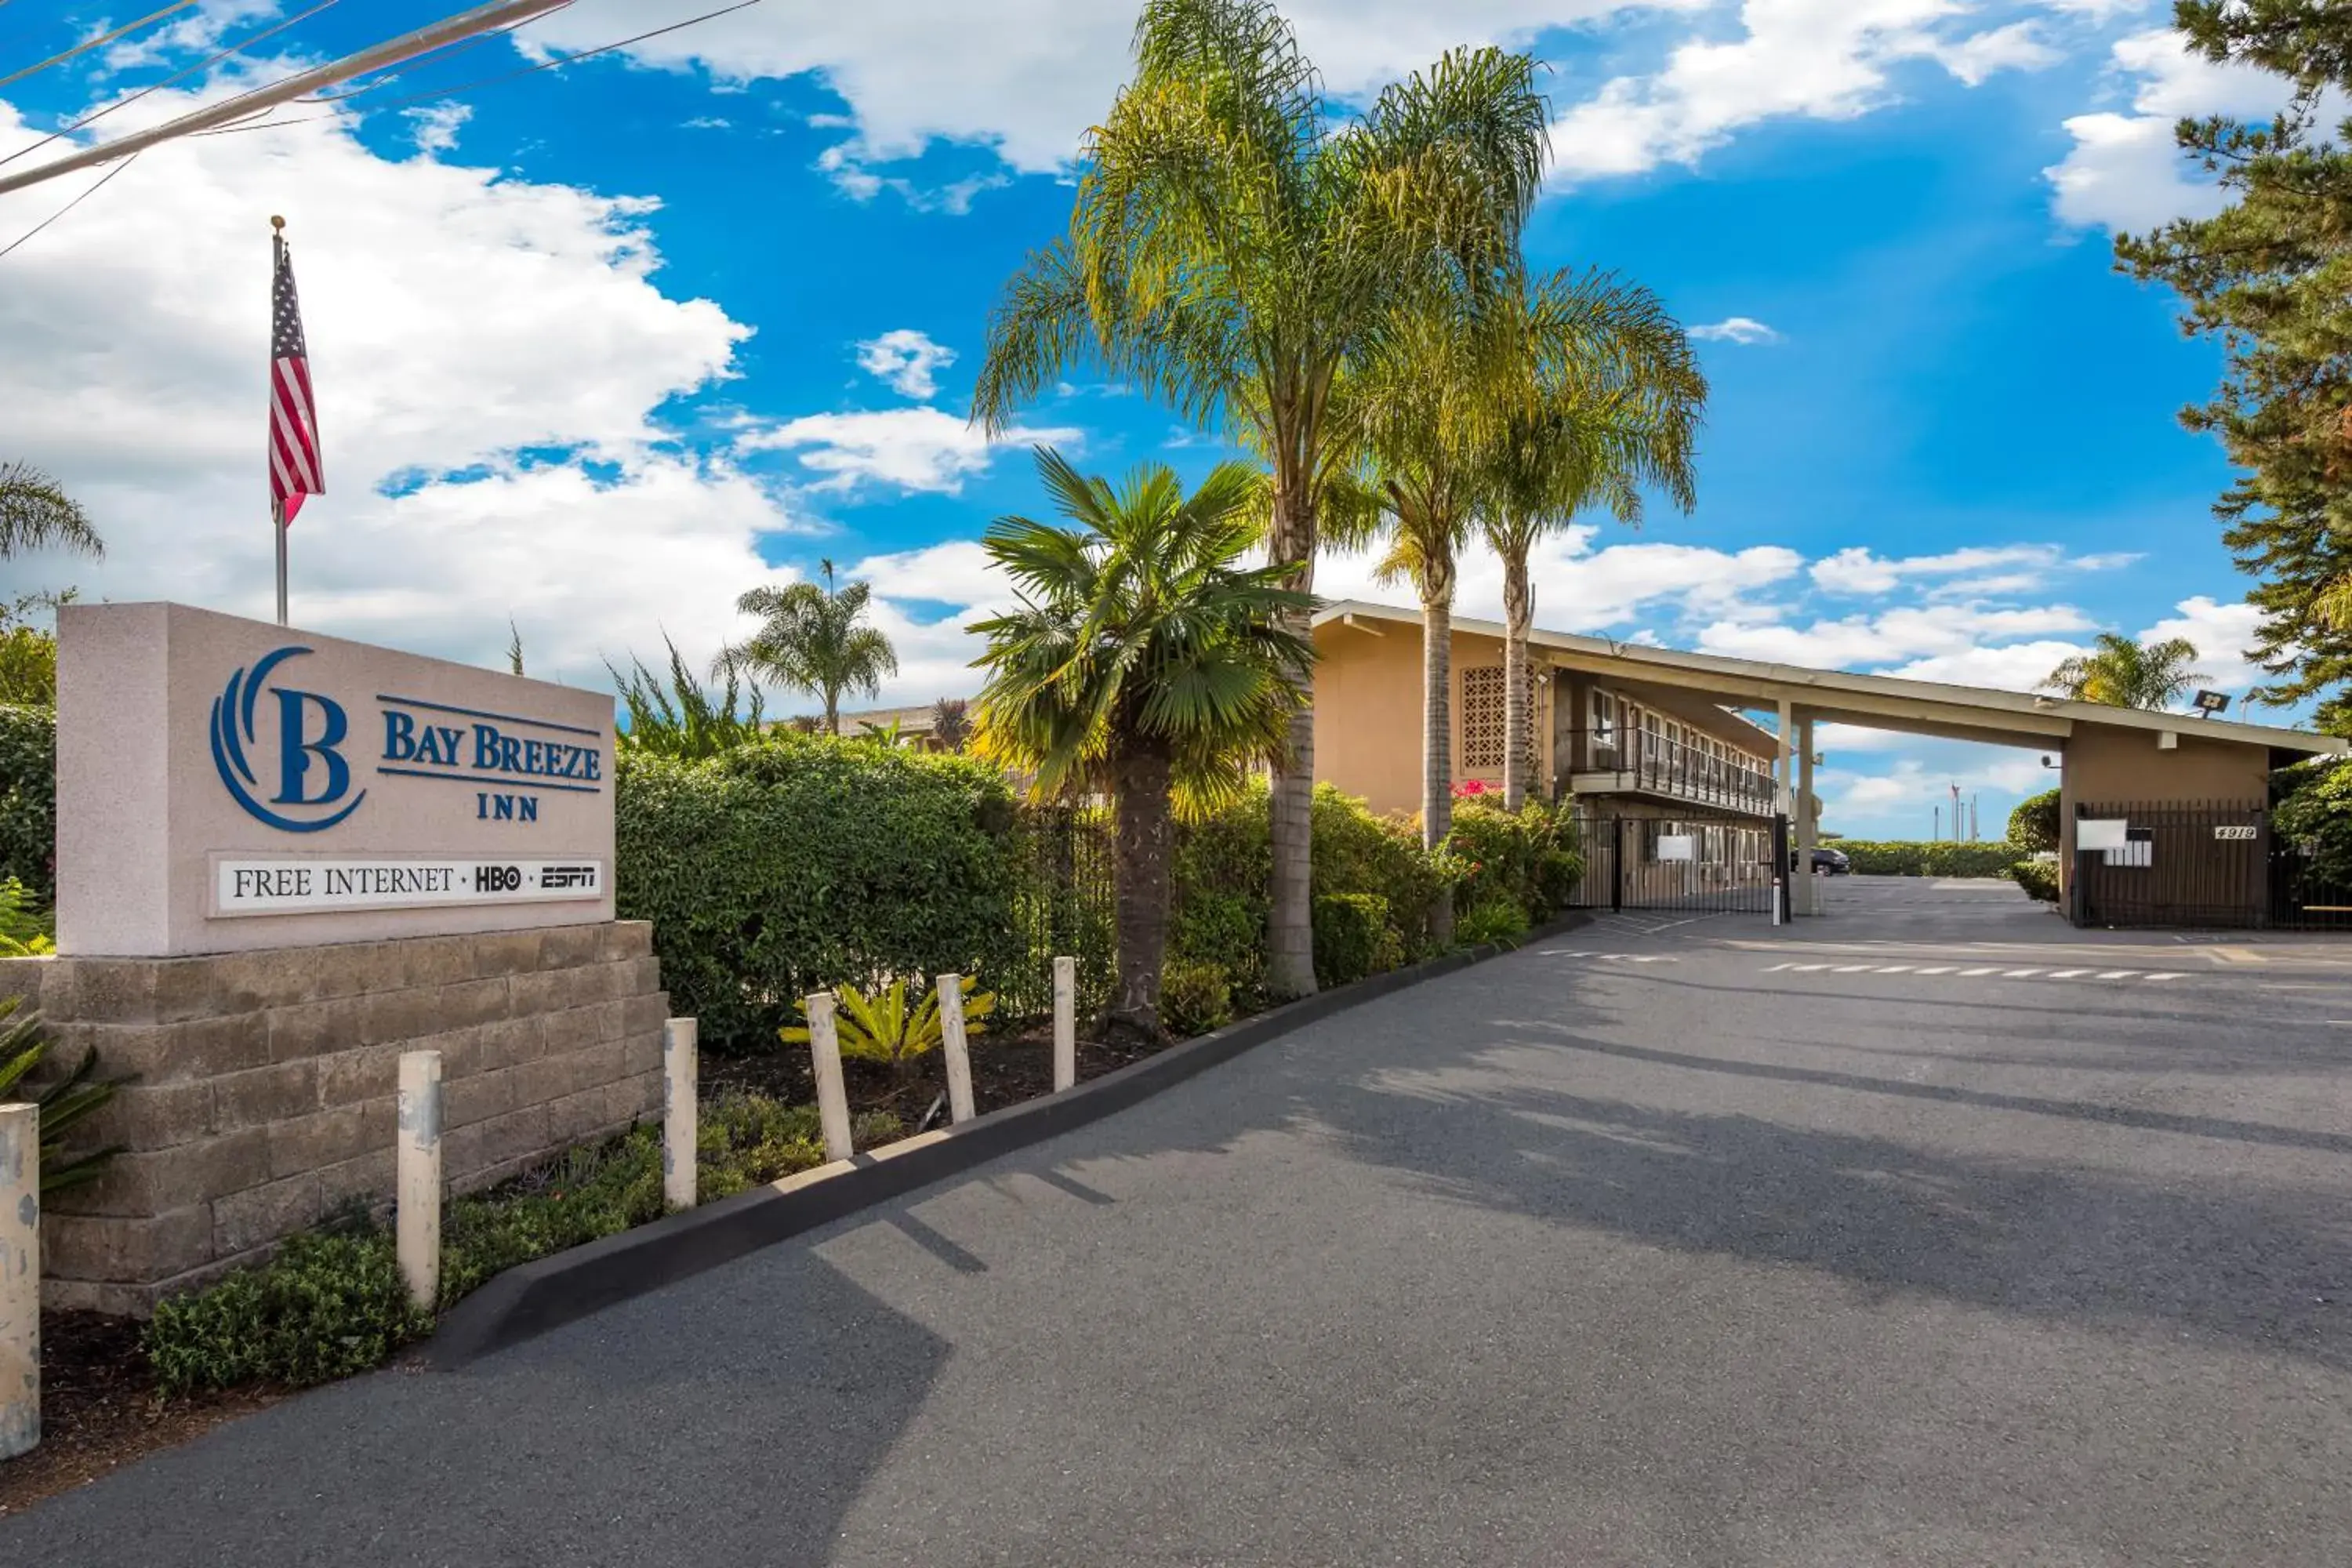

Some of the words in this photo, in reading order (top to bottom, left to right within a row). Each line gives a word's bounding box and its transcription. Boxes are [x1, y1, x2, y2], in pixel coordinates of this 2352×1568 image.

[382, 710, 465, 766] BAY
[472, 724, 601, 781] BREEZE
[477, 793, 539, 822] INN
[2217, 828, 2254, 837] 4919
[234, 869, 311, 898] FREE
[325, 867, 454, 895] INTERNET
[475, 866, 521, 892] HBO
[541, 867, 595, 888] ESPN
